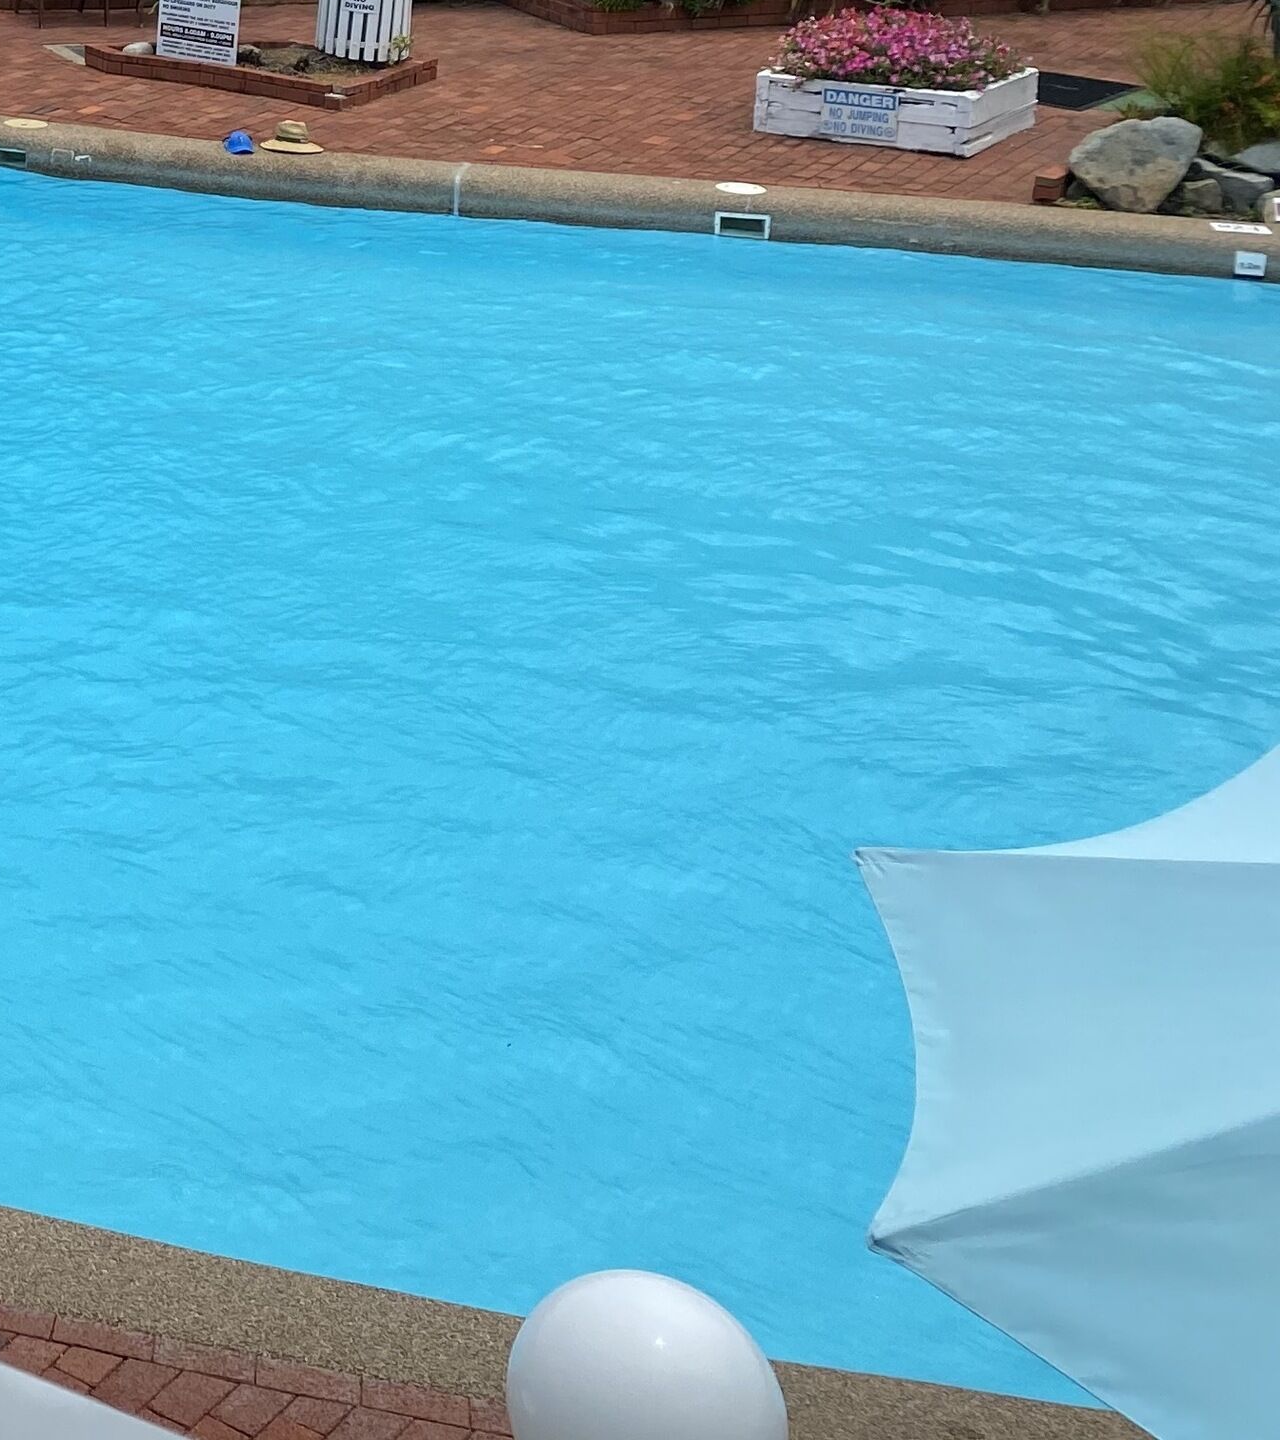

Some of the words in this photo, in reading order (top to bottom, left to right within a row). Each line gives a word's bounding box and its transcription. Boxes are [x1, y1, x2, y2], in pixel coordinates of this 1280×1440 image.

[344, 1, 375, 11] DIVING
[826, 91, 895, 109] DANGER
[829, 107, 843, 120] NO
[847, 109, 889, 124] JUMPING
[833, 121, 847, 134] NO
[850, 123, 884, 138] DIVING
